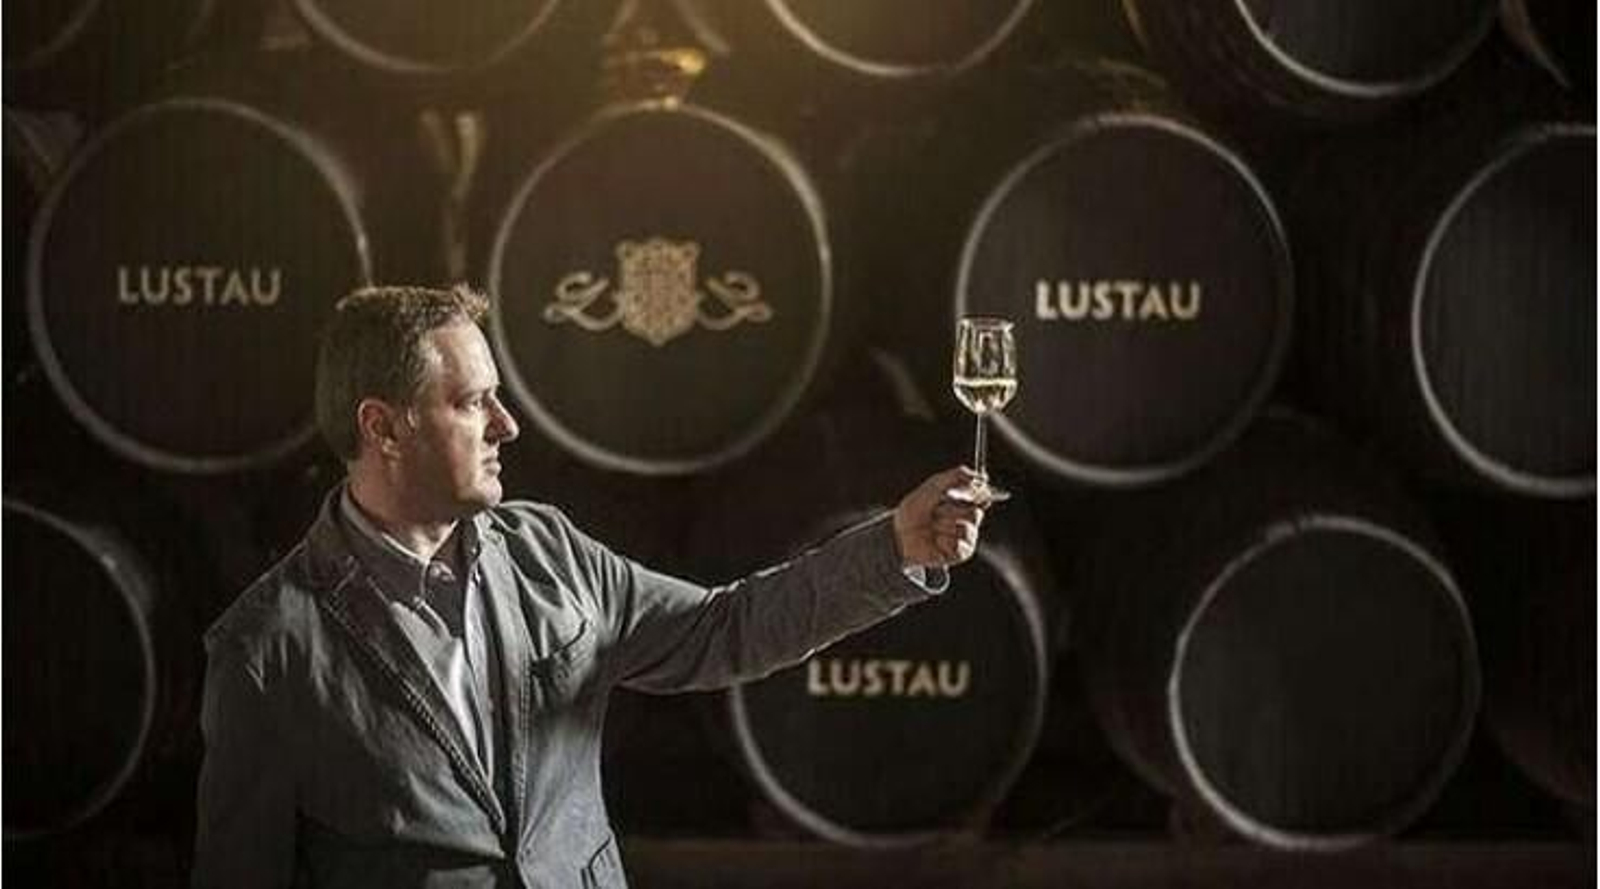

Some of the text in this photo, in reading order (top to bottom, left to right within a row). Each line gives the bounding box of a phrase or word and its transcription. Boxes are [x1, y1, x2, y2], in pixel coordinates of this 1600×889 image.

[118, 266, 282, 305] LUSTAU
[1035, 280, 1201, 321] LUSTAU
[808, 658, 970, 698] LUSTAU
